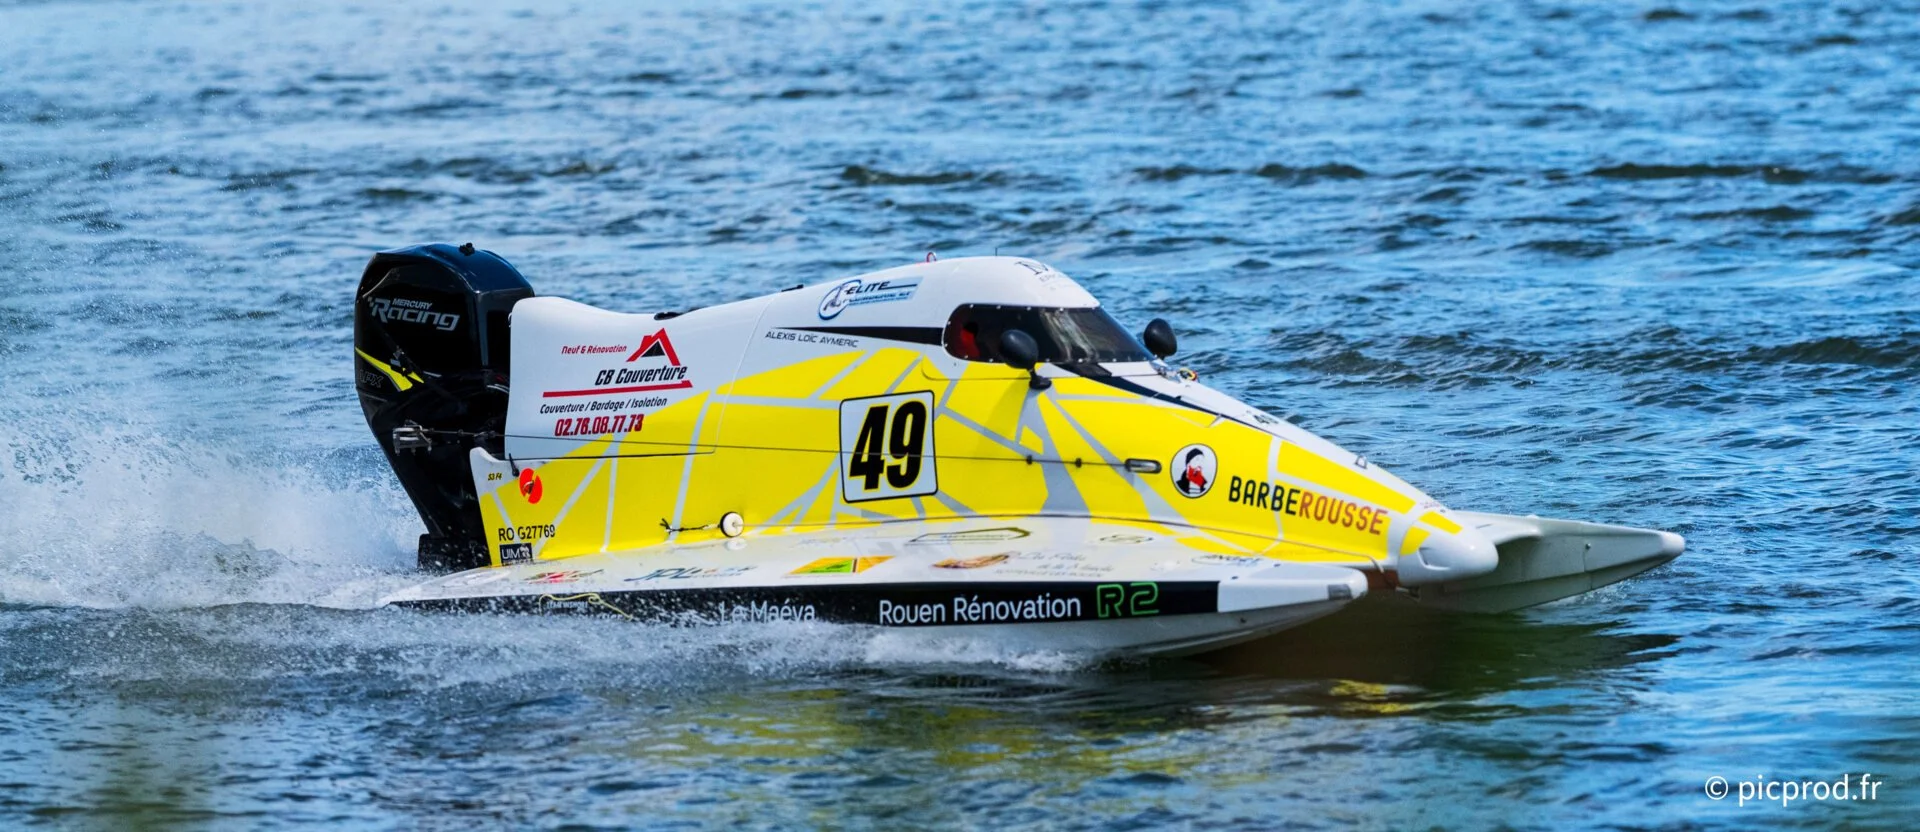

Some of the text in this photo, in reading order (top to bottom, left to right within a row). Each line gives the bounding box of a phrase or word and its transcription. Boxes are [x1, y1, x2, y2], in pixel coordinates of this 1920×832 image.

[846, 281, 890, 295] ELITE
[392, 298, 432, 310] MERCURY
[371, 298, 460, 331] Racing
[580, 345, 586, 354] &
[587, 344, 627, 354] Rénovation
[765, 331, 859, 348] ALEXIS LOÏC AYMERIC
[595, 365, 687, 386] CB Couverture
[540, 402, 584, 414] Couverture
[590, 400, 624, 412] Bardage
[632, 396, 667, 408] Isolation
[554, 413, 645, 436] 02.76.08.77.73
[849, 400, 927, 490] 49
[1228, 475, 1389, 535] BARBEROUSSE
[498, 524, 556, 541] RO G27769
[501, 548, 520, 560] UIM
[750, 598, 816, 624] Maéva
[879, 600, 945, 625] Rouen
[953, 594, 1081, 621] Rénovation
